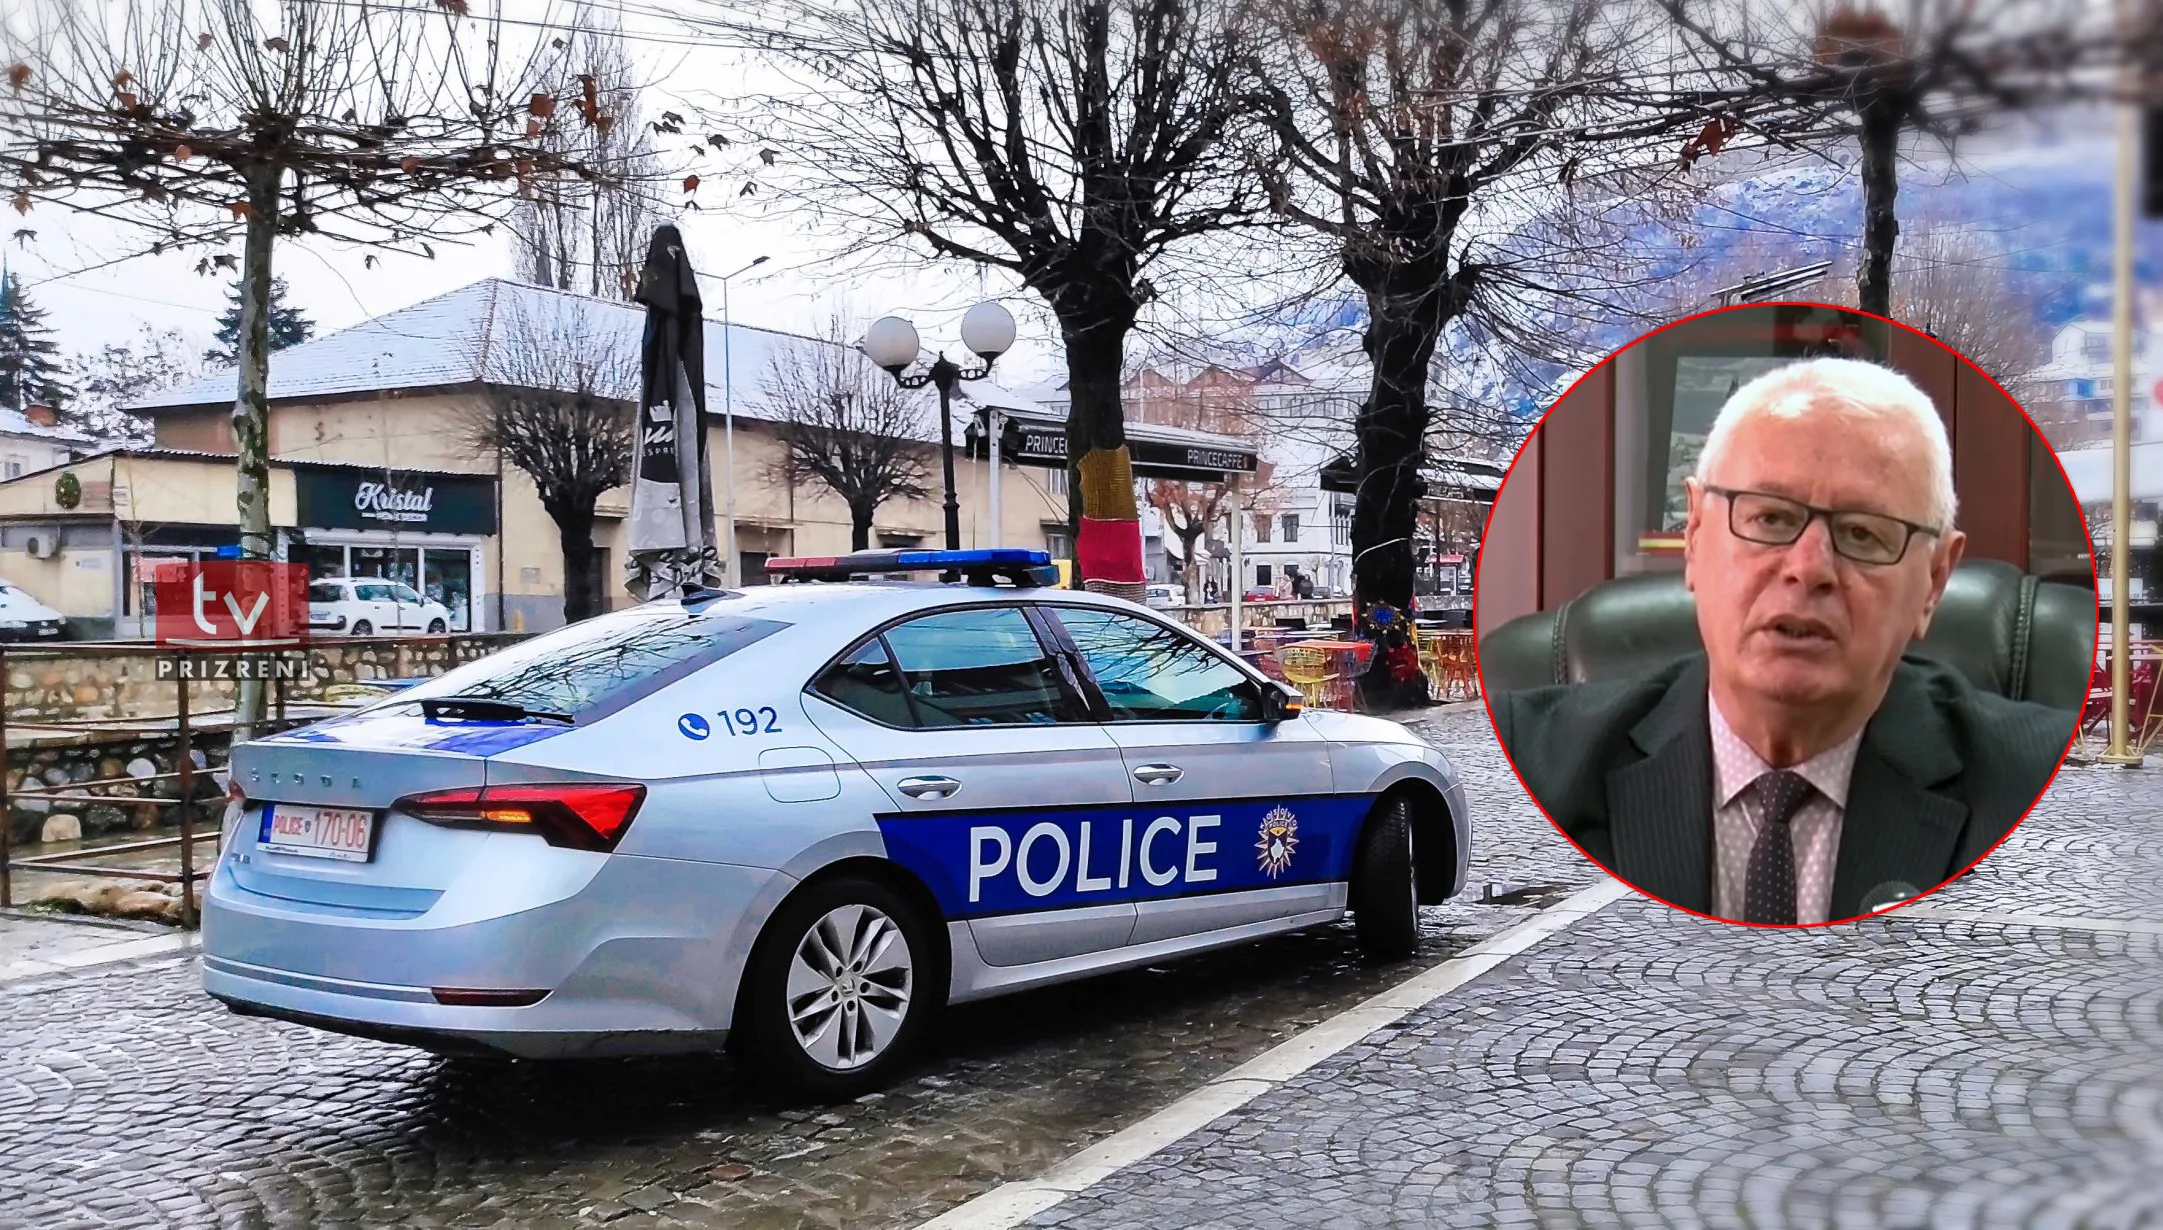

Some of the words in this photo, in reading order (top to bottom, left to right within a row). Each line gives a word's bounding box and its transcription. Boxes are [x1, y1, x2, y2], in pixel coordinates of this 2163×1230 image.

[1187, 449, 1243, 469] PRINCECAFFE
[355, 482, 434, 512] Kristal
[717, 706, 783, 737] 192
[314, 809, 367, 849] 170-06
[969, 814, 1221, 902] POLICE
